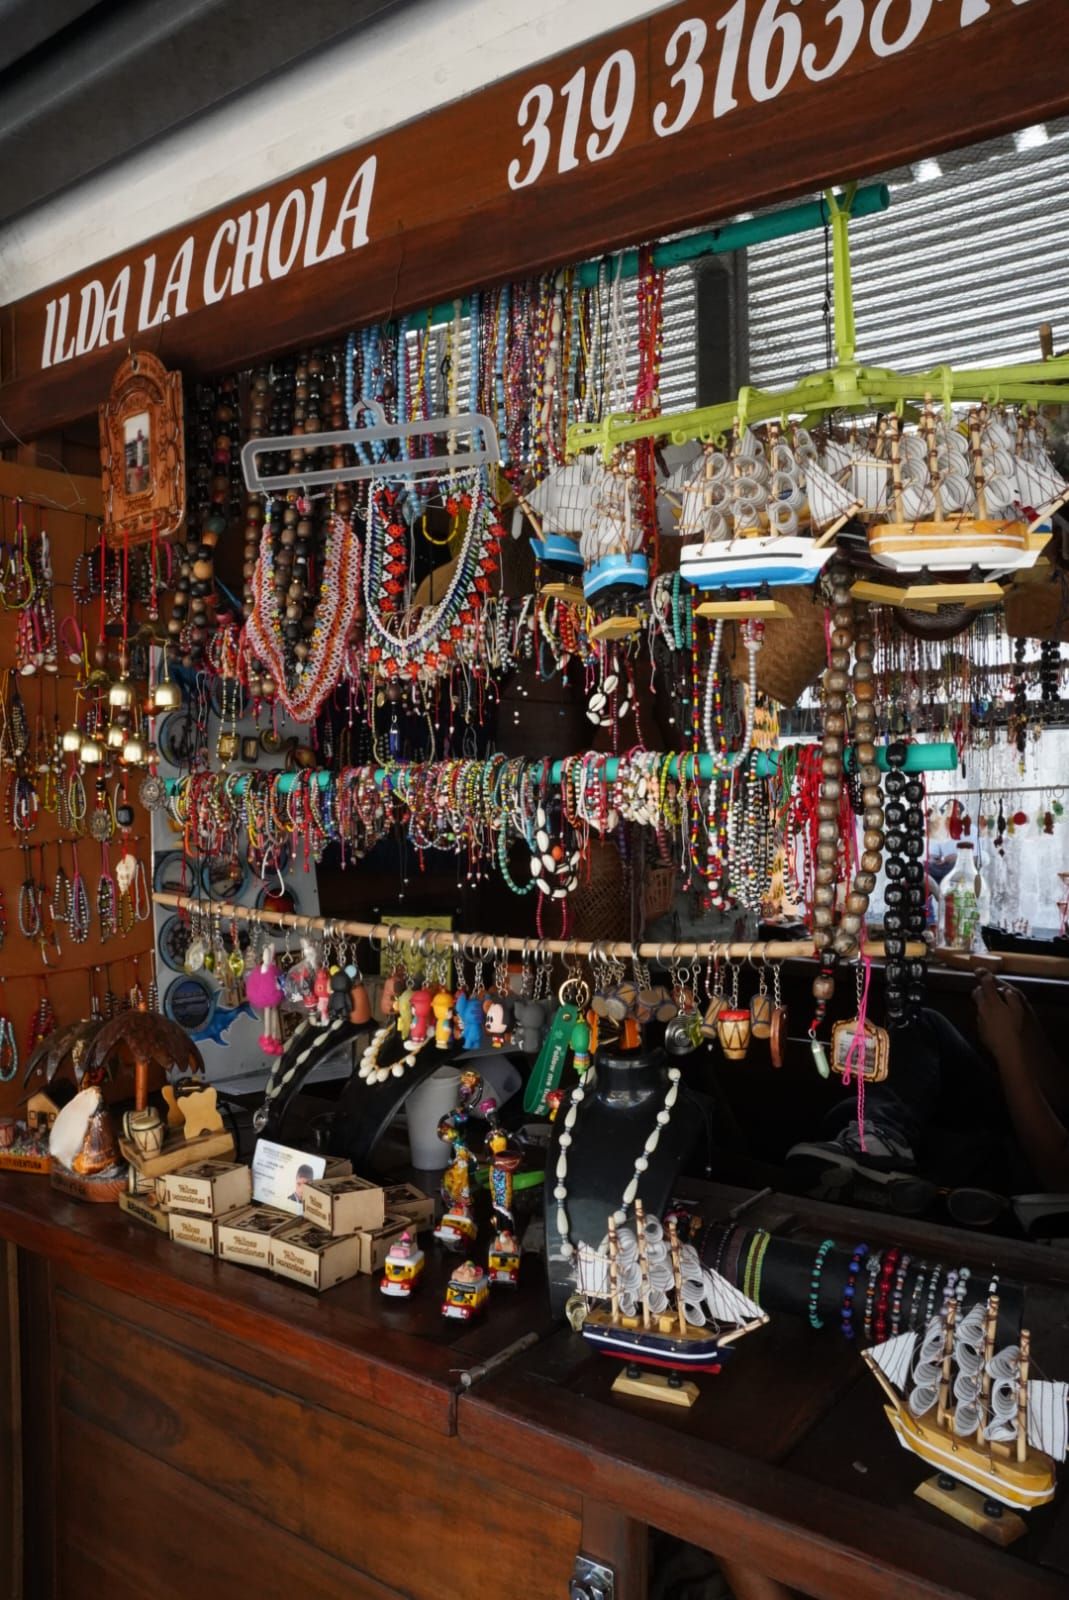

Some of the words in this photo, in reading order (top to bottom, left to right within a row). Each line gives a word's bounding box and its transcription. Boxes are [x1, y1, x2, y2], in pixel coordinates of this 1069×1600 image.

[508, 50, 636, 190] 319
[654, 0, 1028, 138] 3163
[41, 265, 131, 369] ILDA
[138, 236, 194, 332] LA
[203, 155, 377, 306] CHOLA
